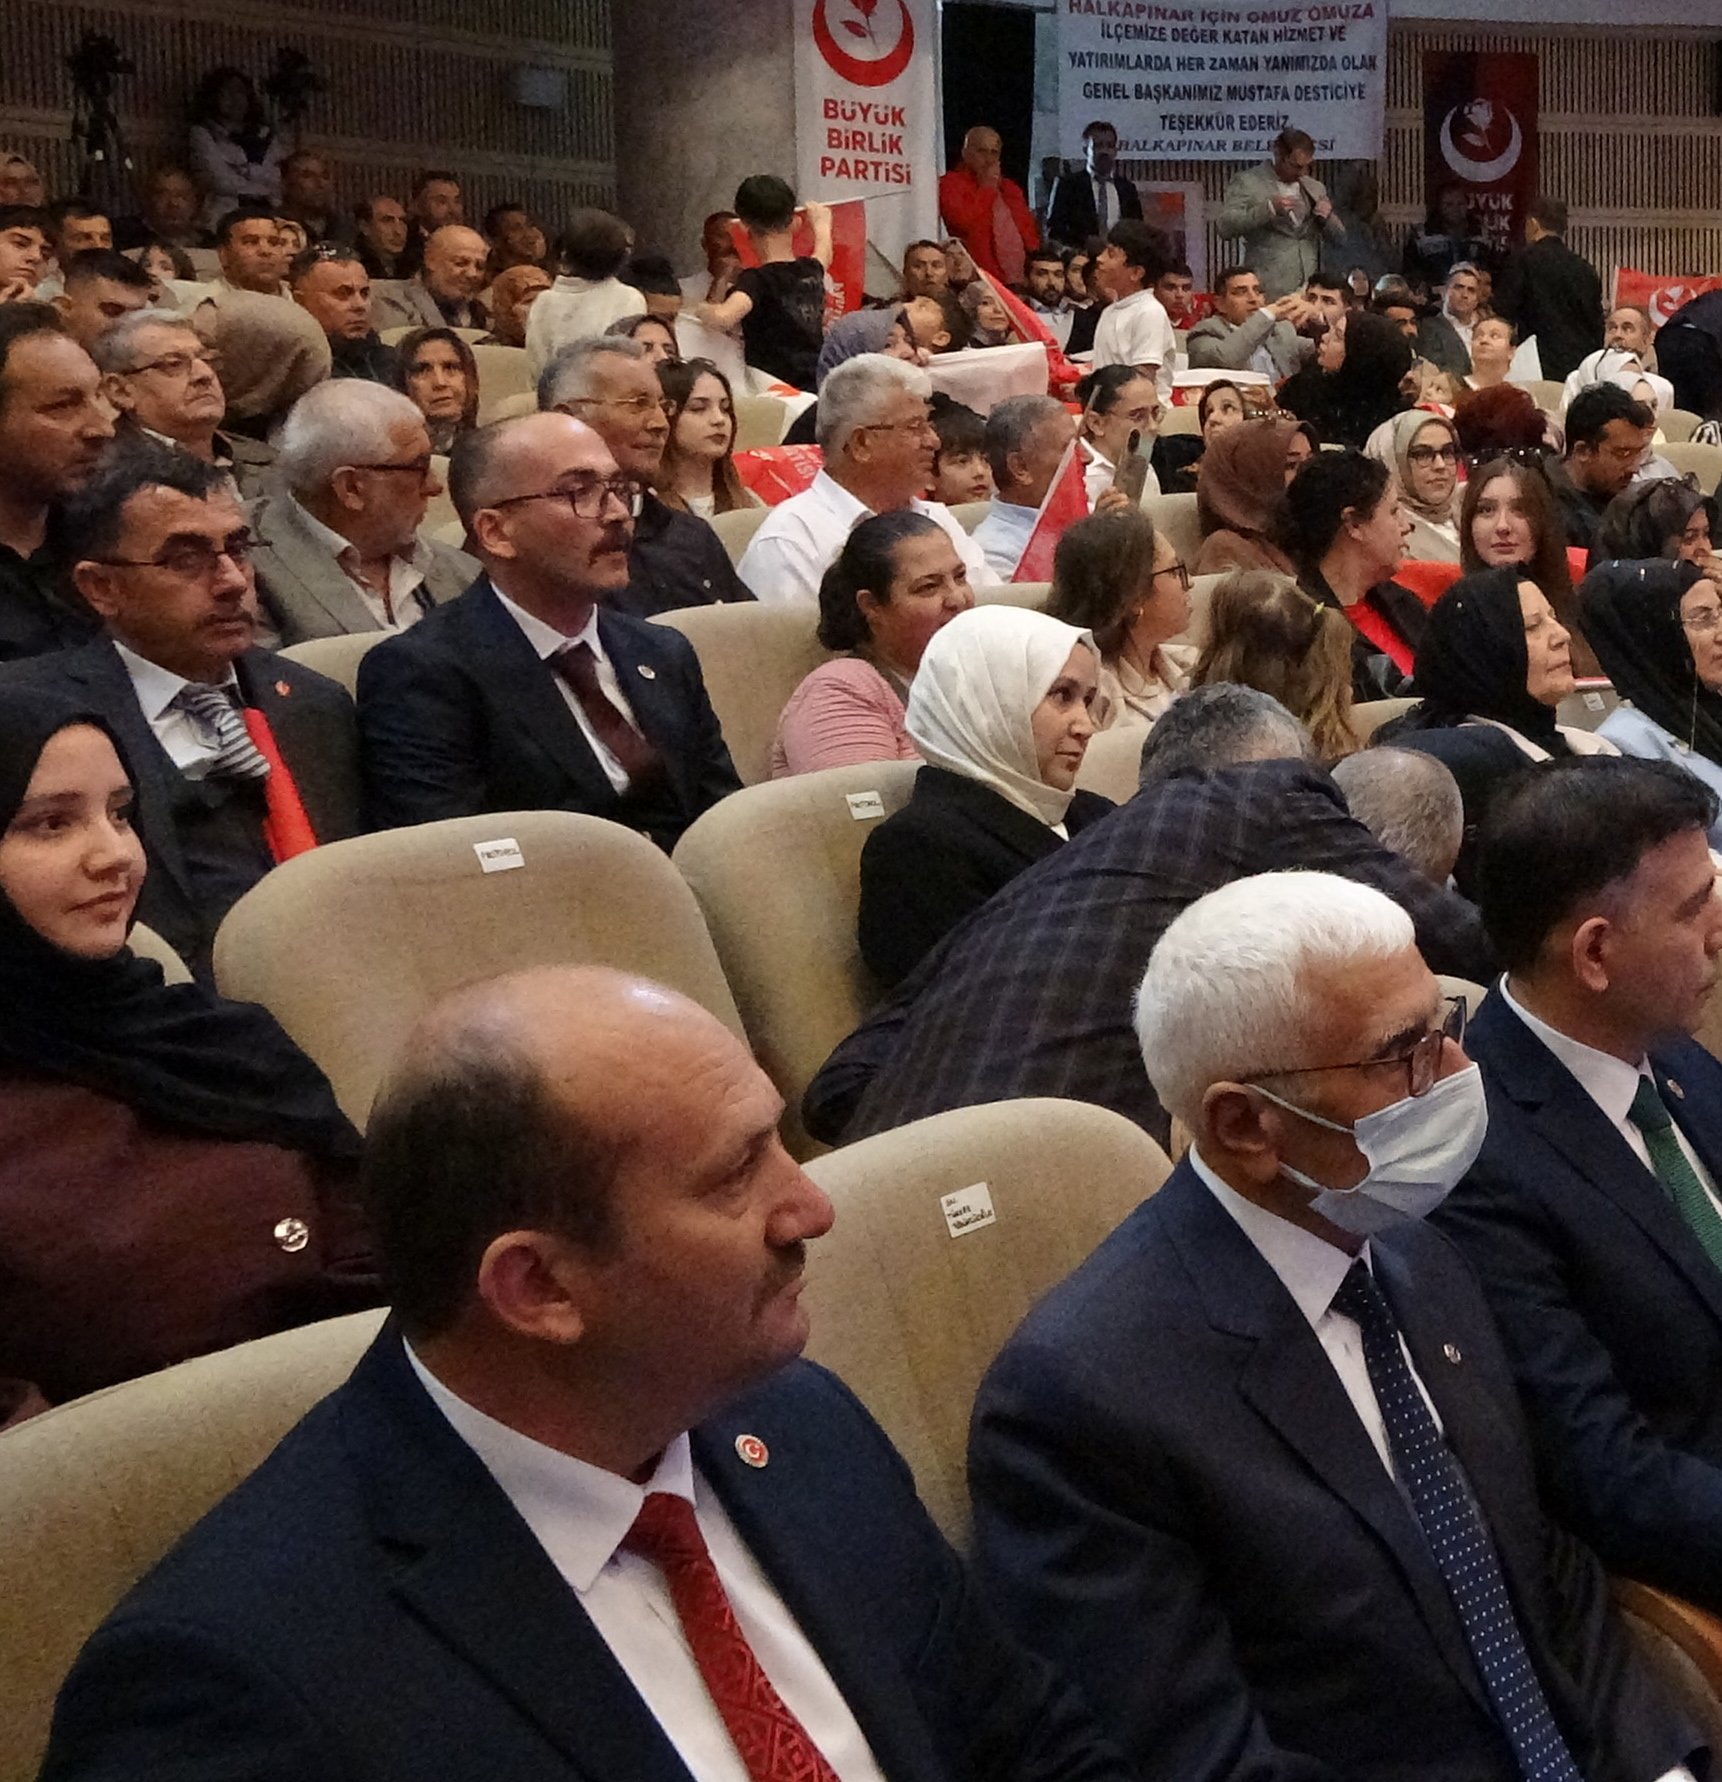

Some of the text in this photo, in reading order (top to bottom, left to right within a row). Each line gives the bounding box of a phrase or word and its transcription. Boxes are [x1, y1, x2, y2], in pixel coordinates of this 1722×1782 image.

[1068, 0, 1194, 22] HALKAPINAR
[1246, 10, 1302, 24] OMUZ
[1307, 3, 1375, 22] OMUZA
[1101, 19, 1347, 45] İLÇEMİZE DEĞER KATAN HİZMET VE
[1068, 51, 1377, 73] YATIRIMLARDA HER ZAMAN YANIMIZDA OLAN
[1082, 81, 1130, 100] GENEL
[1134, 82, 1223, 105] BAŞKANIMIZ
[1226, 83, 1291, 101] MUSTAFA
[823, 97, 906, 128] BÜYÜK
[1160, 111, 1236, 135] TEŞEKKÜR
[826, 127, 904, 156] BİRLİK
[1117, 138, 1227, 152] HALKAPINAR
[820, 155, 912, 185] PARTİSİ
